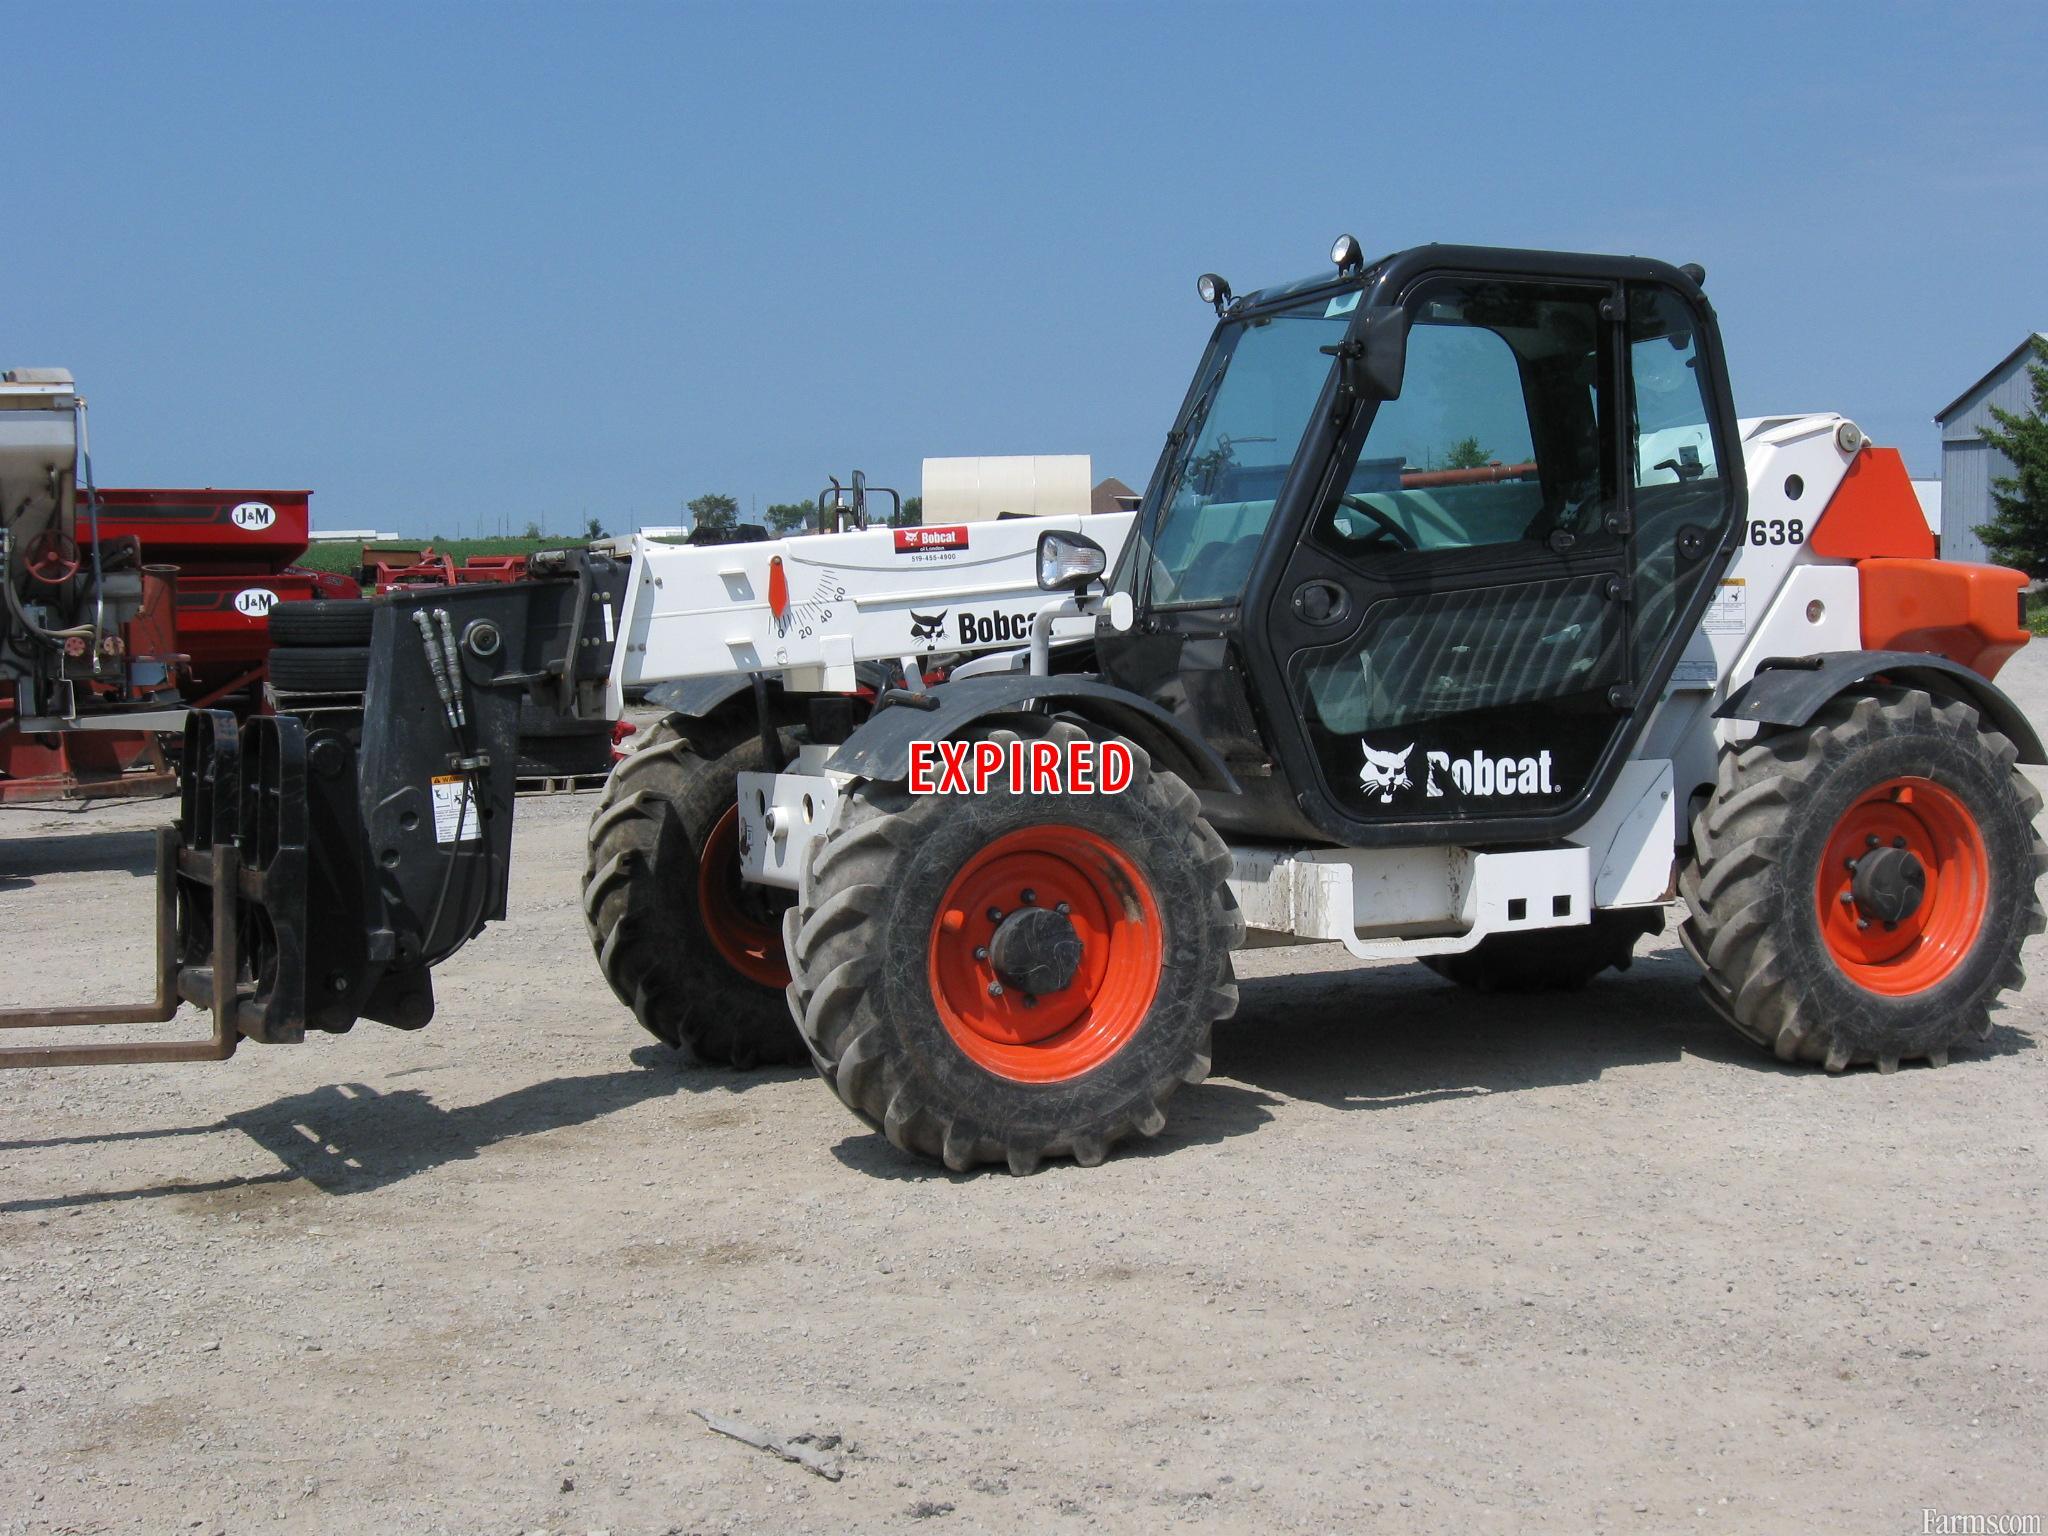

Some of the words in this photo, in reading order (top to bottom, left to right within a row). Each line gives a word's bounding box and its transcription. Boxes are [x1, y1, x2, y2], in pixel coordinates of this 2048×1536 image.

[236, 507, 269, 525] J&M
[921, 531, 956, 544] Bobcat
[911, 553, 957, 562] 519-455-4900
[833, 587, 846, 602] 60
[239, 594, 272, 611] J&M
[820, 609, 833, 624] 40
[777, 628, 785, 639] 0
[798, 625, 813, 640] 20
[958, 610, 1054, 645] Bobc
